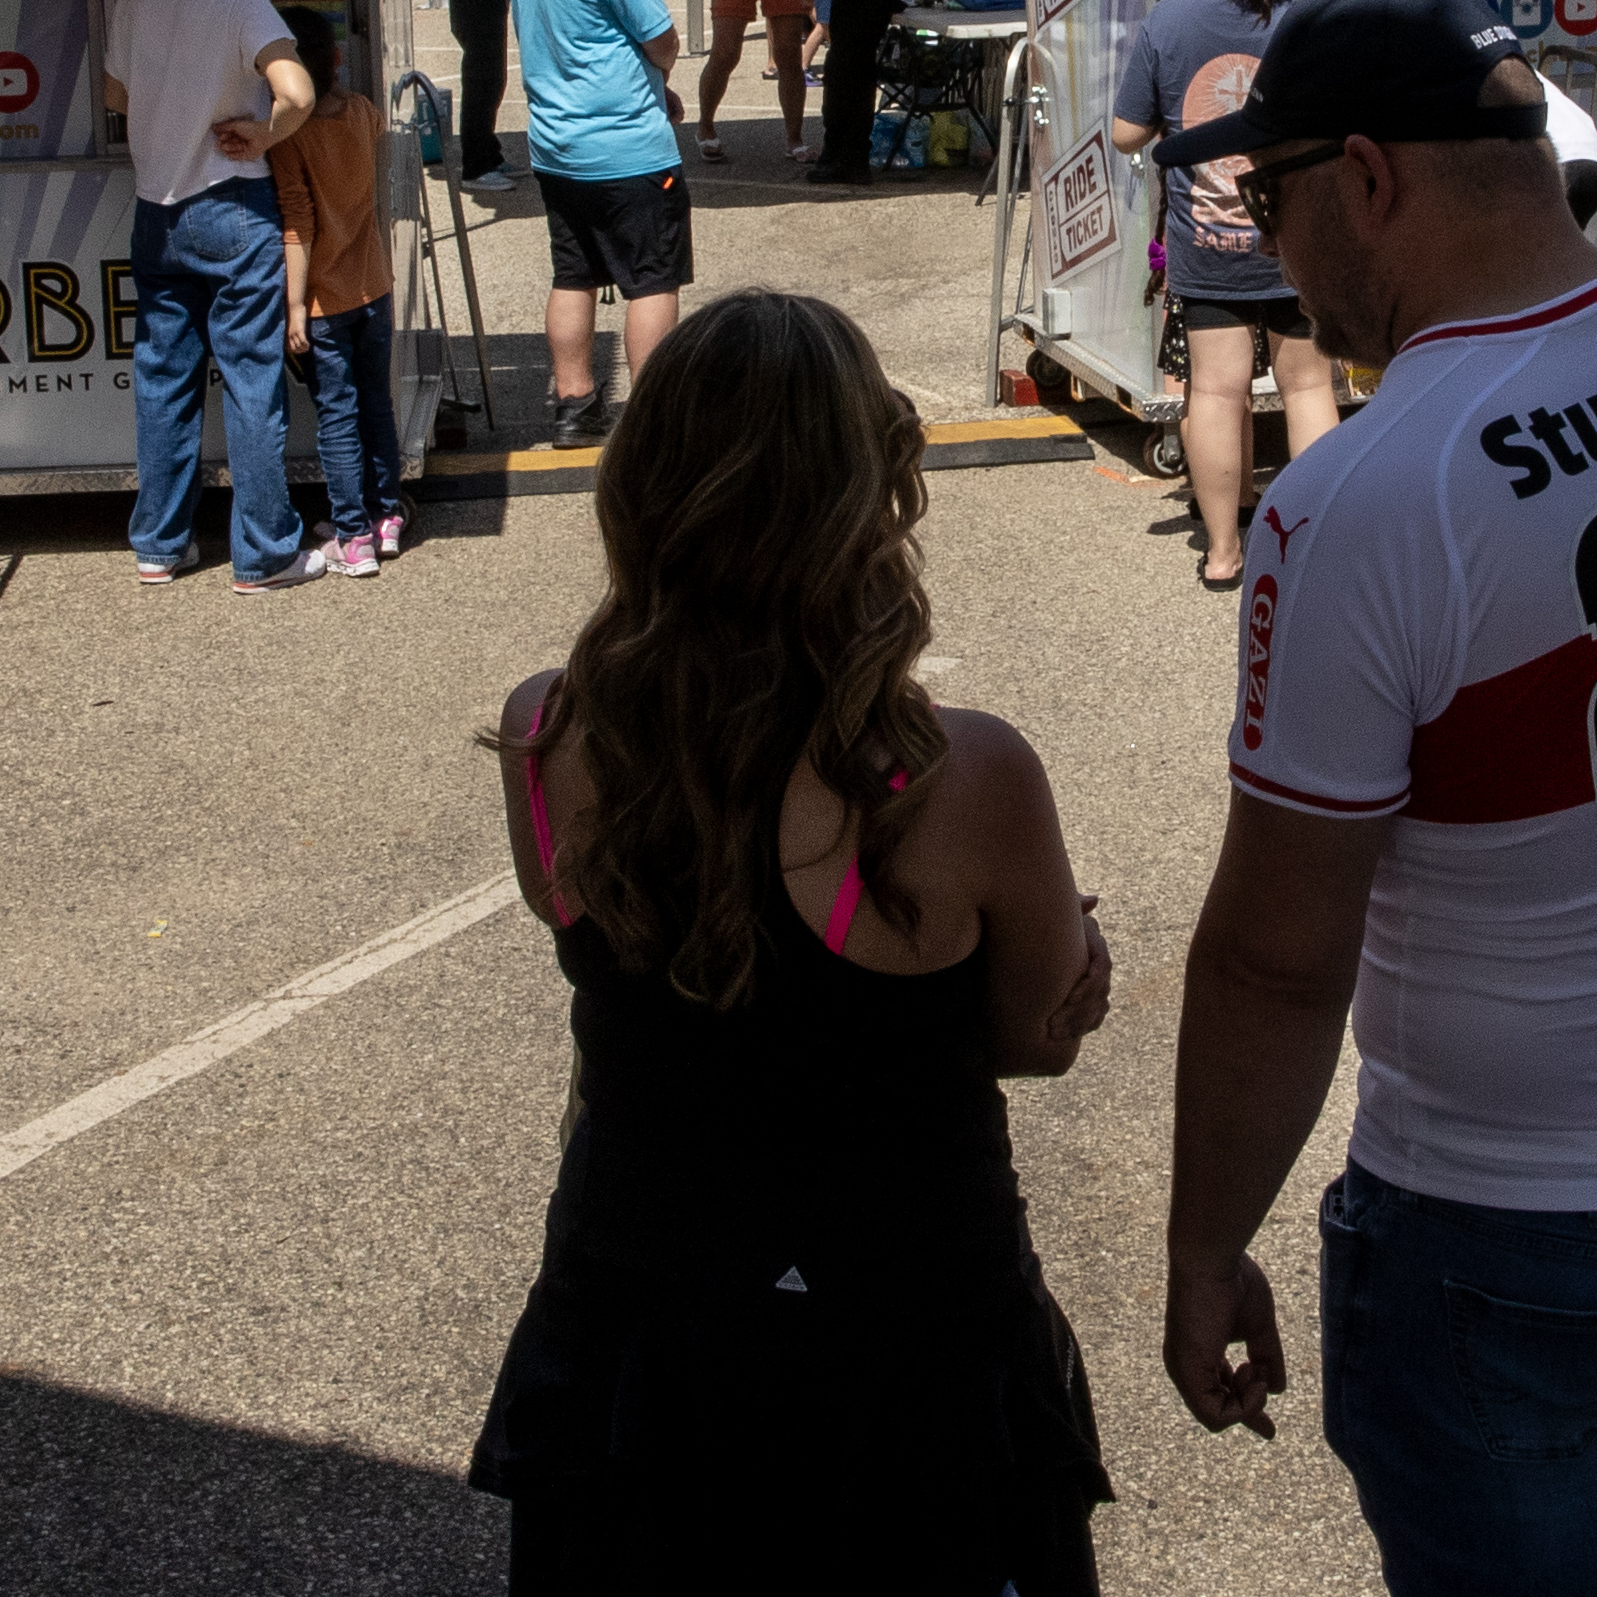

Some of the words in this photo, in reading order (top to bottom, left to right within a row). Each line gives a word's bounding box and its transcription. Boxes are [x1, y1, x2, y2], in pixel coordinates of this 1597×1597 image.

[1063, 156, 1097, 213] RIDE
[1065, 204, 1105, 253] TICKET
[1246, 593, 1274, 735] GAZI
